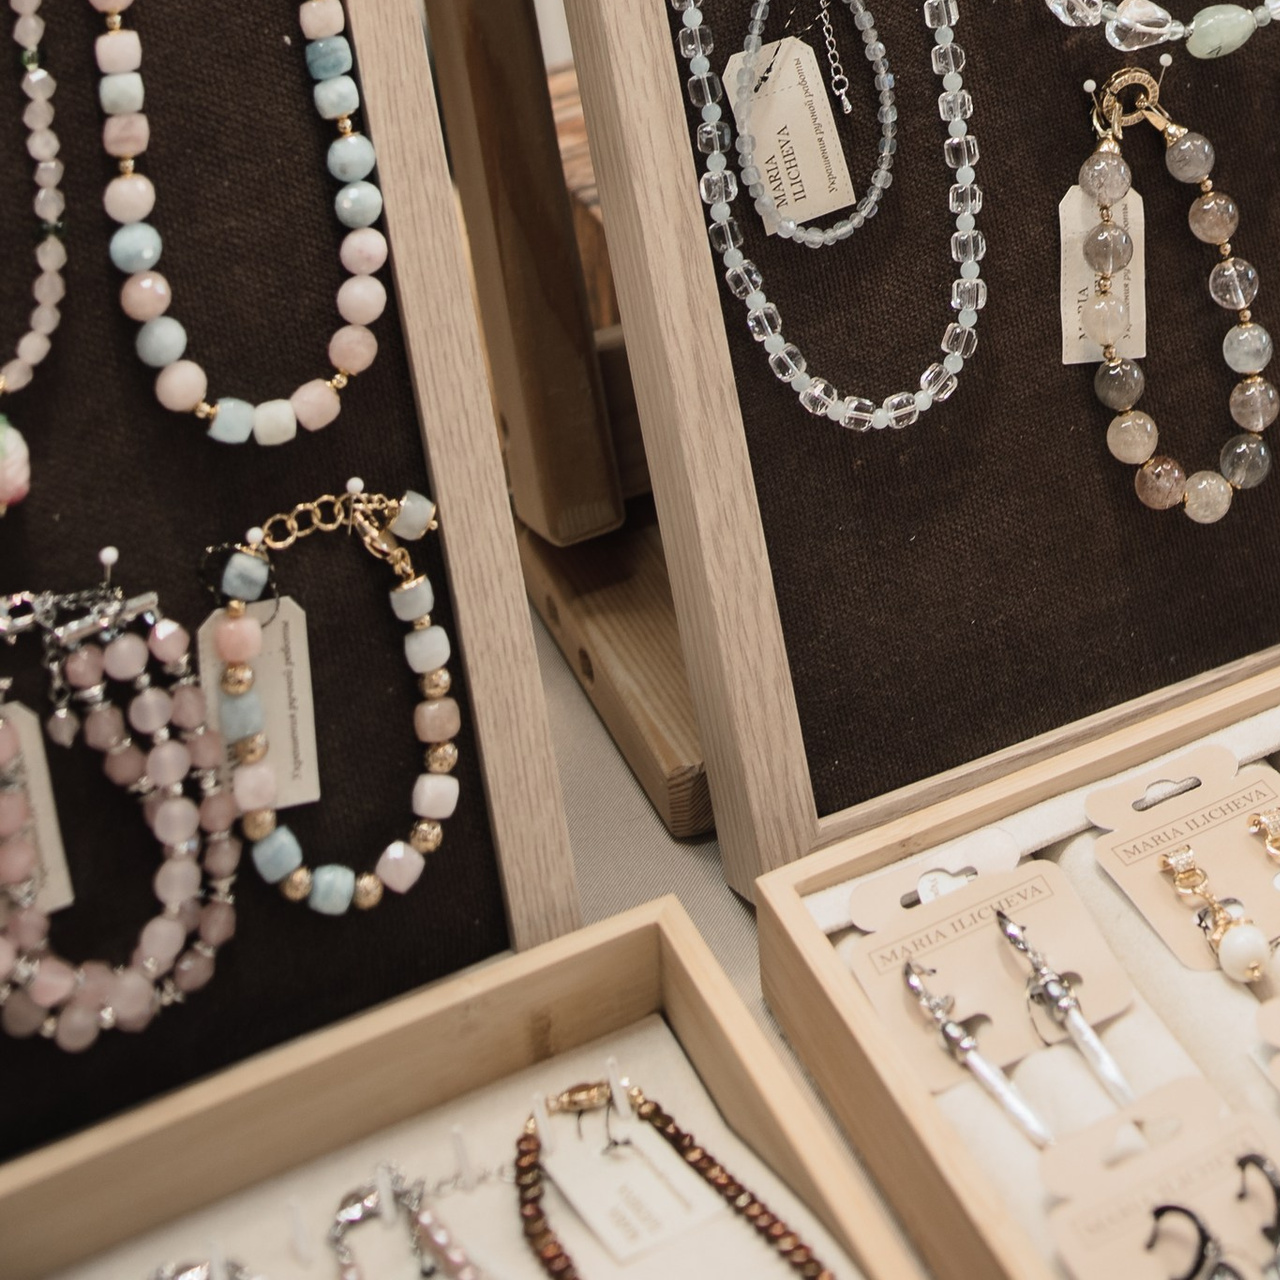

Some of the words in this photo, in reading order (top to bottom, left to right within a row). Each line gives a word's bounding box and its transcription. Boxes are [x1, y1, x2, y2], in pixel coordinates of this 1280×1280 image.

[794, 57, 814, 100] работы
[804, 100, 825, 136] ручной
[764, 154, 789, 209] MARIA
[776, 124, 807, 202] ILICHEVA
[816, 136, 838, 193] Украшения
[1121, 826, 1183, 860] MARIA
[1185, 789, 1268, 832] ILICHEVA
[880, 928, 947, 968] MARIA
[951, 883, 1044, 934] ILICHEVA
